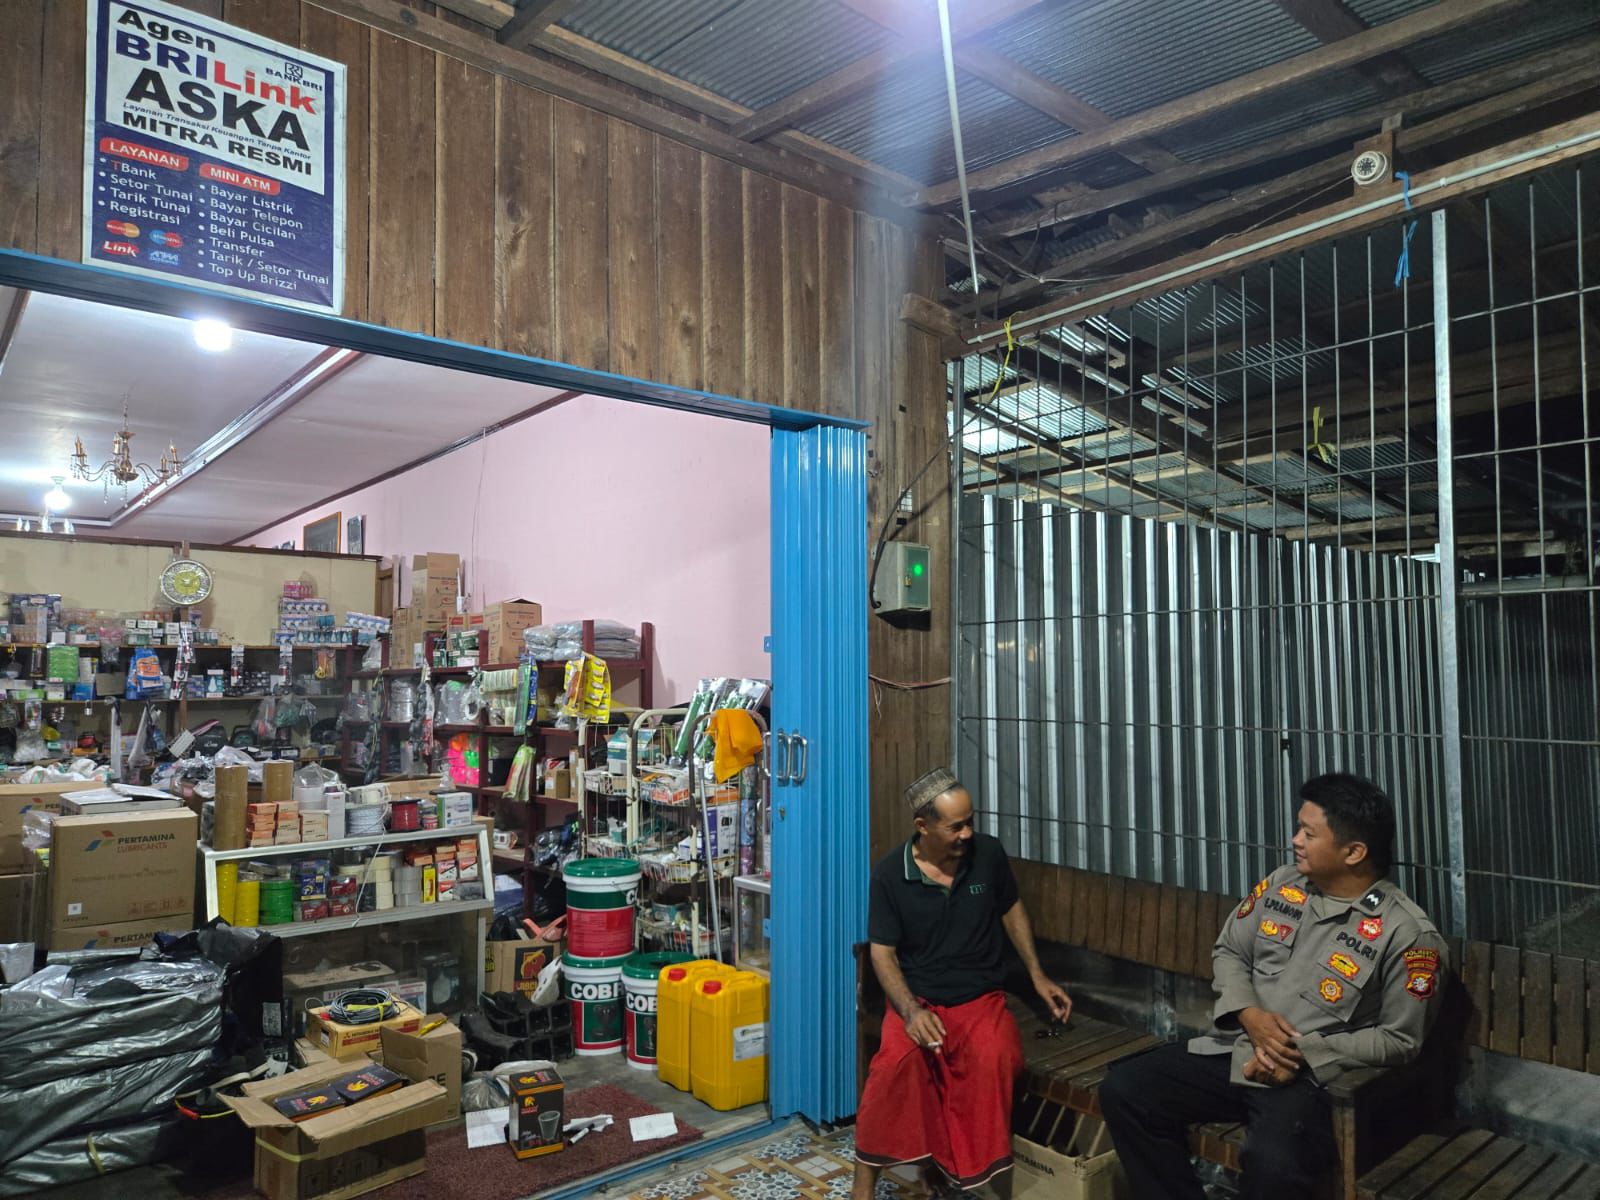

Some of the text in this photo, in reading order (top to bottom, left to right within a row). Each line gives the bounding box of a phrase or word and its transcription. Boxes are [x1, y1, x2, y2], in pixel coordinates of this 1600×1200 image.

[117, 9, 216, 52] Agen
[116, 30, 317, 114] BRILink
[266, 67, 323, 92] BANK BRI
[126, 68, 310, 150] ASKA
[123, 103, 164, 118] Layanan
[166, 114, 211, 131] Transaksi
[284, 148, 311, 160] Kantor
[123, 112, 312, 175] MITRA RESMI
[110, 142, 180, 168] LAYANAN
[110, 174, 193, 202] Setor Tunai
[210, 167, 272, 192] MINI ATM
[110, 188, 191, 215] Tarik Tunai
[110, 201, 180, 225] Registrasi
[210, 185, 294, 215] Bayar Listrik
[209, 211, 297, 240] Bayar Cicilan
[210, 198, 303, 230] Bayar Telepon
[103, 240, 138, 258] Link
[209, 224, 275, 248] Beli Pulsa
[209, 237, 265, 258] Transfer
[209, 250, 243, 265] Tarik
[257, 260, 291, 276] Setor
[295, 269, 329, 285] Tunai
[209, 263, 298, 291] Top Up Brizzi
[117, 842, 169, 854] LUBRICANTS
[118, 832, 175, 845] PERTAMINA
[114, 930, 161, 944] PERTAM
[1336, 931, 1378, 961] POLRI
[626, 992, 658, 1013] COB
